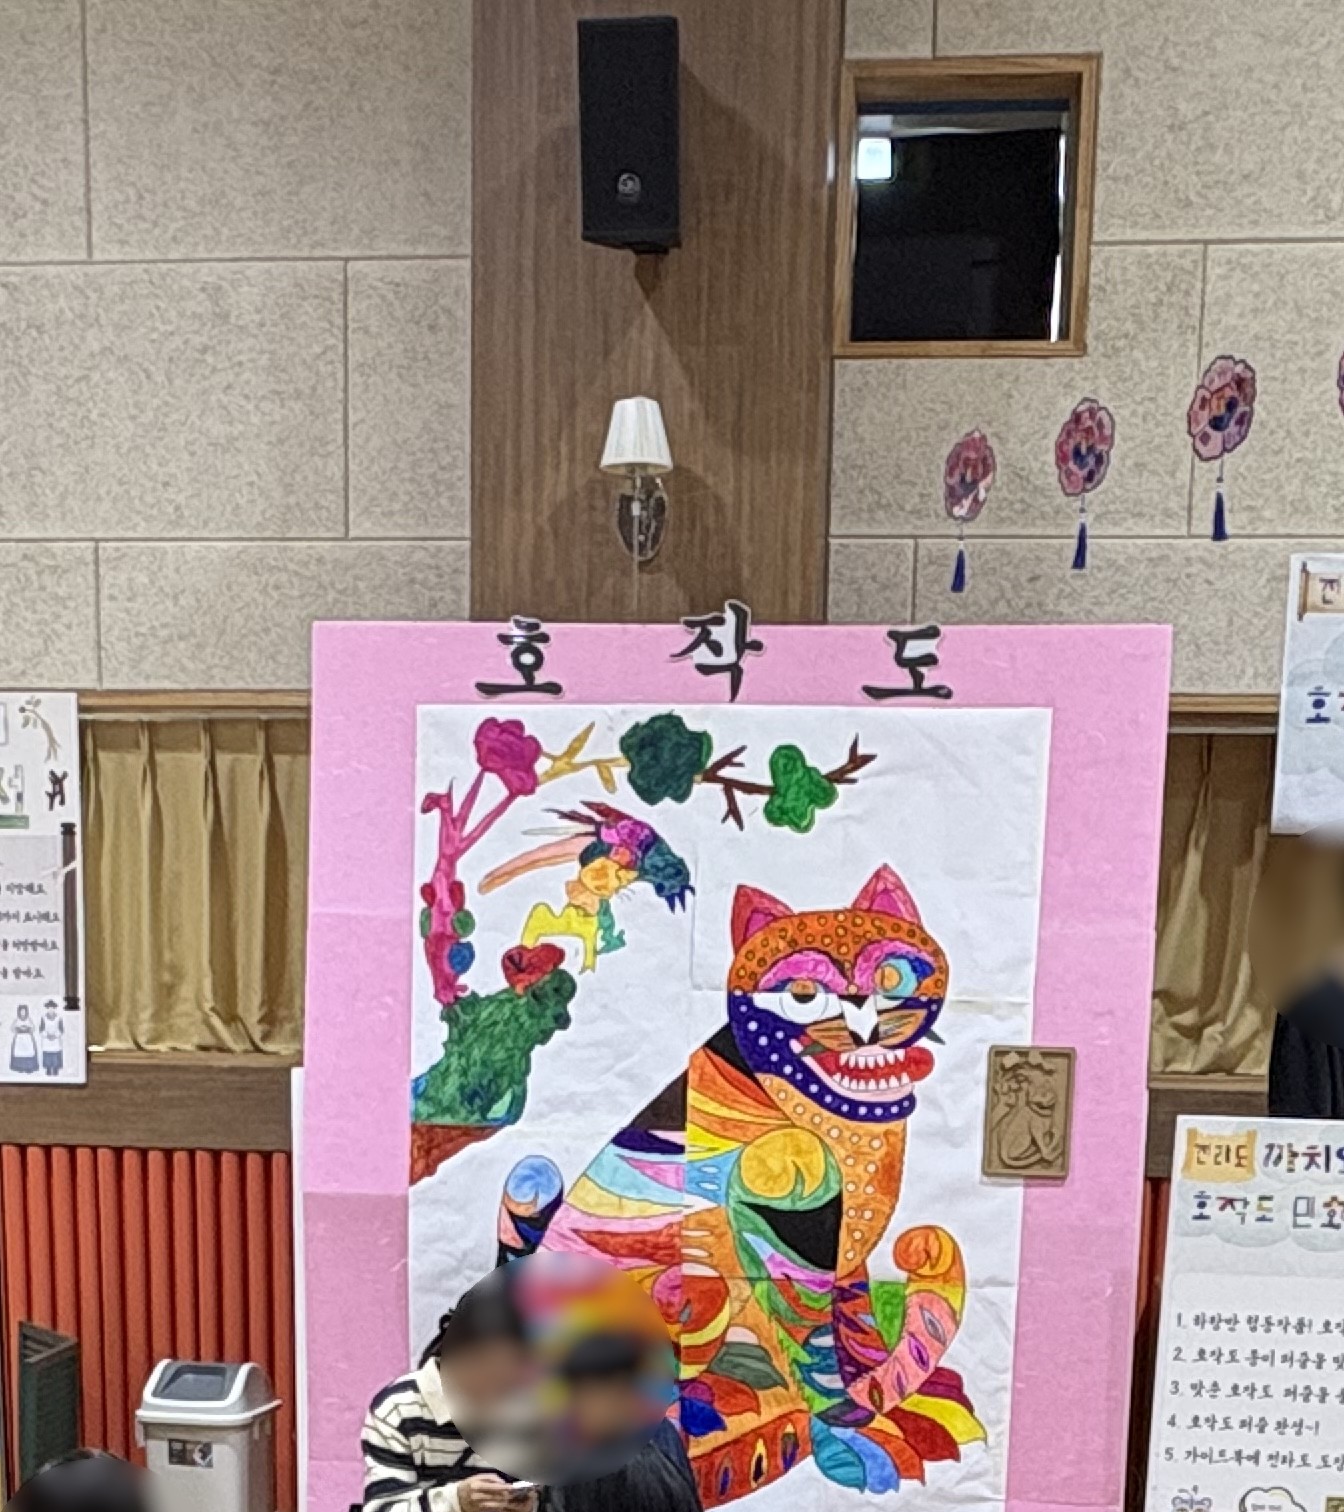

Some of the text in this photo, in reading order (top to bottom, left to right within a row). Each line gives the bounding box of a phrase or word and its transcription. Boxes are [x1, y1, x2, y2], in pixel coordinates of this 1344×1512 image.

[1194, 1142, 1250, 1169] 전라도
[1191, 1190, 1275, 1226] 호작도
[1191, 1346, 1240, 1366] 호작도
[1225, 1381, 1274, 1401] 호작도
[1186, 1413, 1234, 1432] 호작도
[1183, 1446, 1262, 1468] 가이드북에
